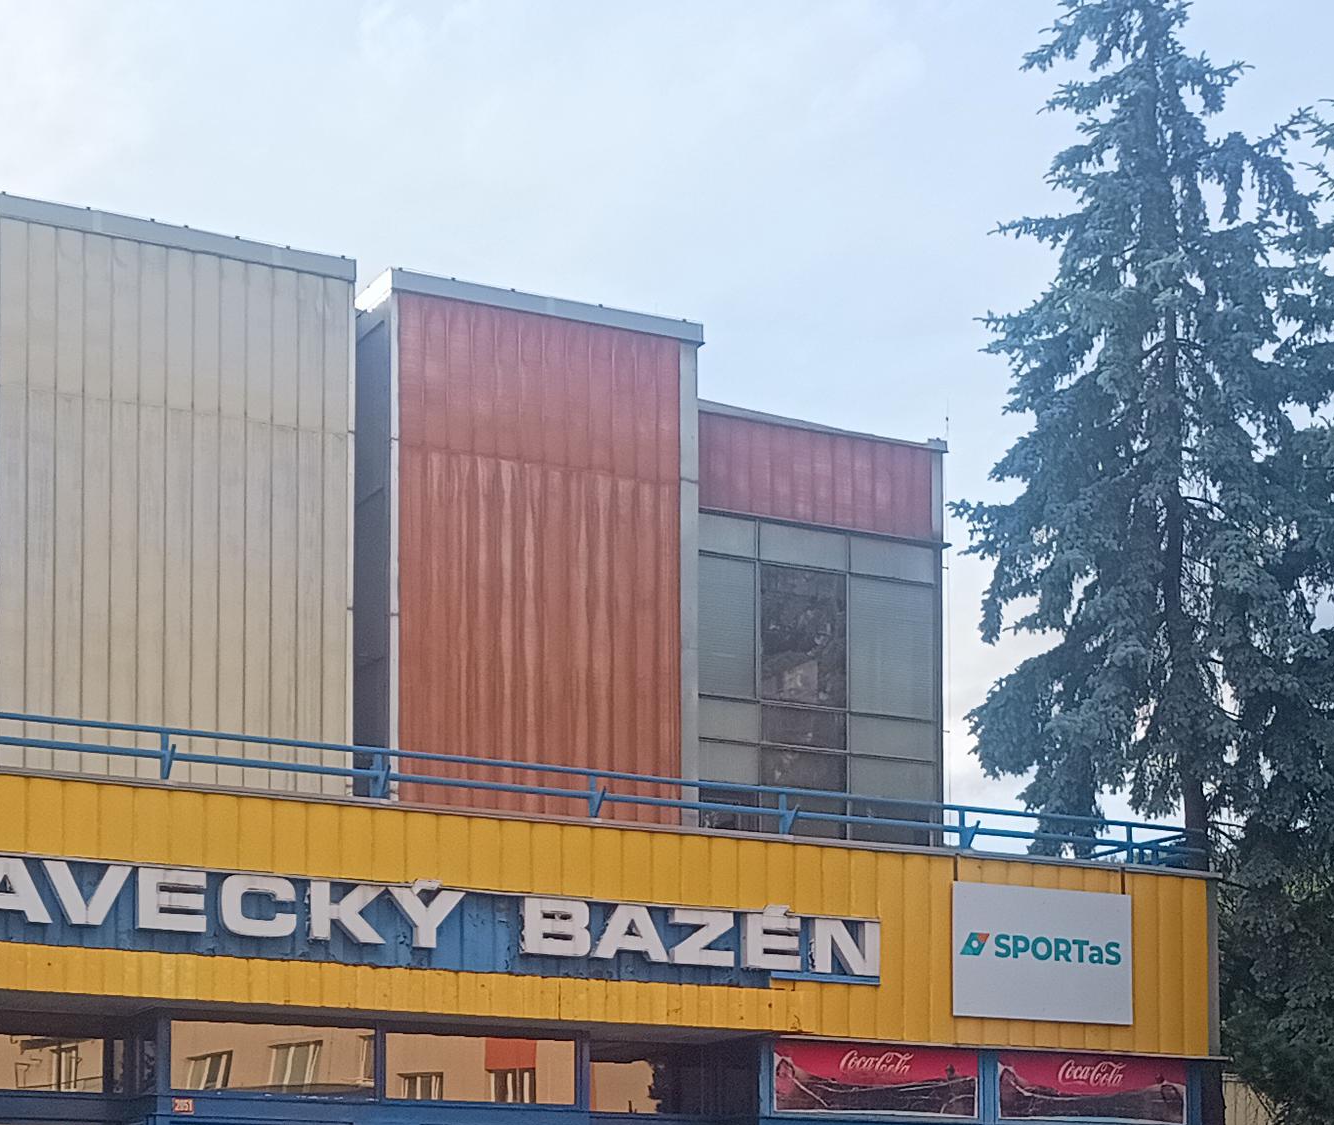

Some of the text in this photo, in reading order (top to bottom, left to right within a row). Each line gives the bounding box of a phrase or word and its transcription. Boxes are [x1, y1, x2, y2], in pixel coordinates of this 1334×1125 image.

[520, 896, 880, 977] BAZÉN
[994, 933, 1121, 965] SPORTaS
[1058, 1060, 1126, 1087] Coca-Cola
